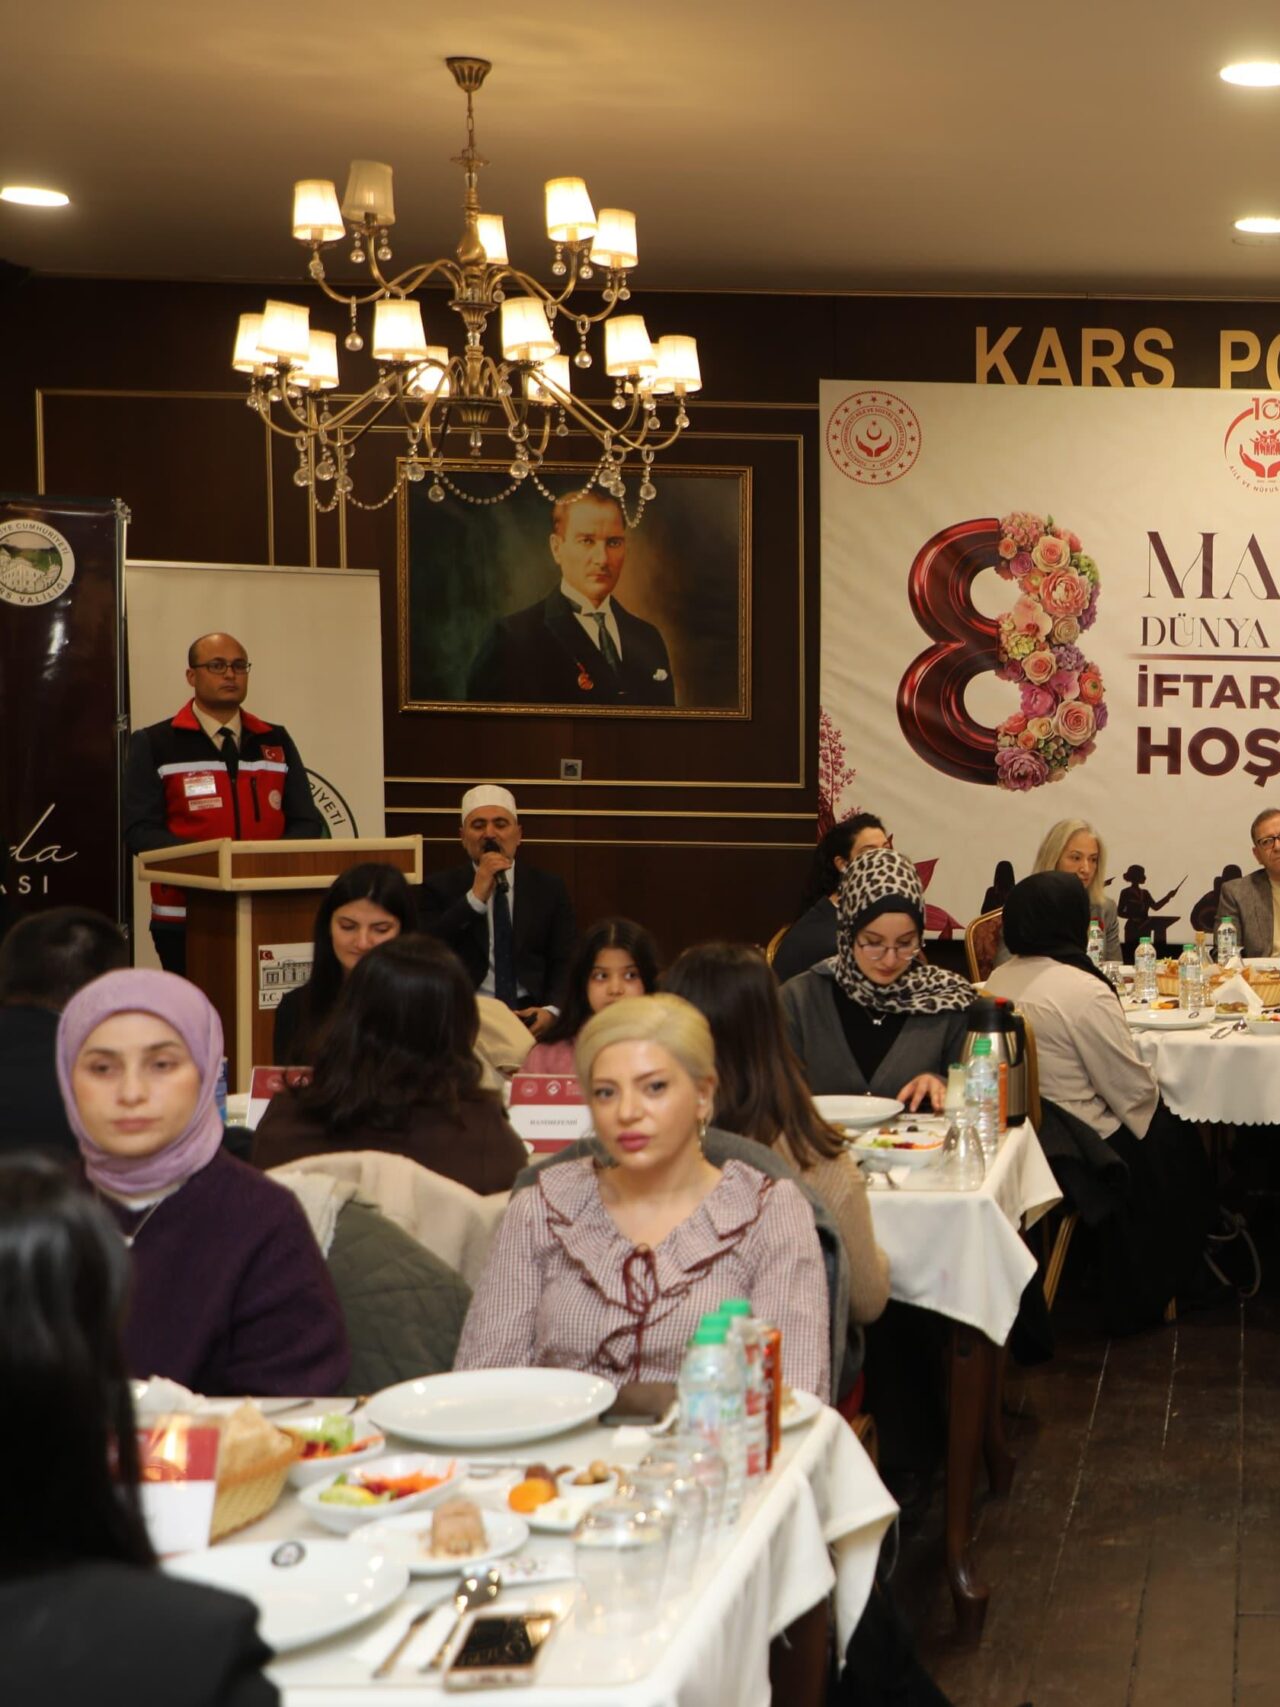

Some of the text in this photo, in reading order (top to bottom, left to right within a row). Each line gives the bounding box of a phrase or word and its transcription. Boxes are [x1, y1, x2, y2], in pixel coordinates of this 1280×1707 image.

[975, 326, 1175, 388] KARS
[896, 511, 1109, 793] 8
[1140, 612, 1271, 648] DÜNYA
[1137, 664, 1280, 710] İFTAR
